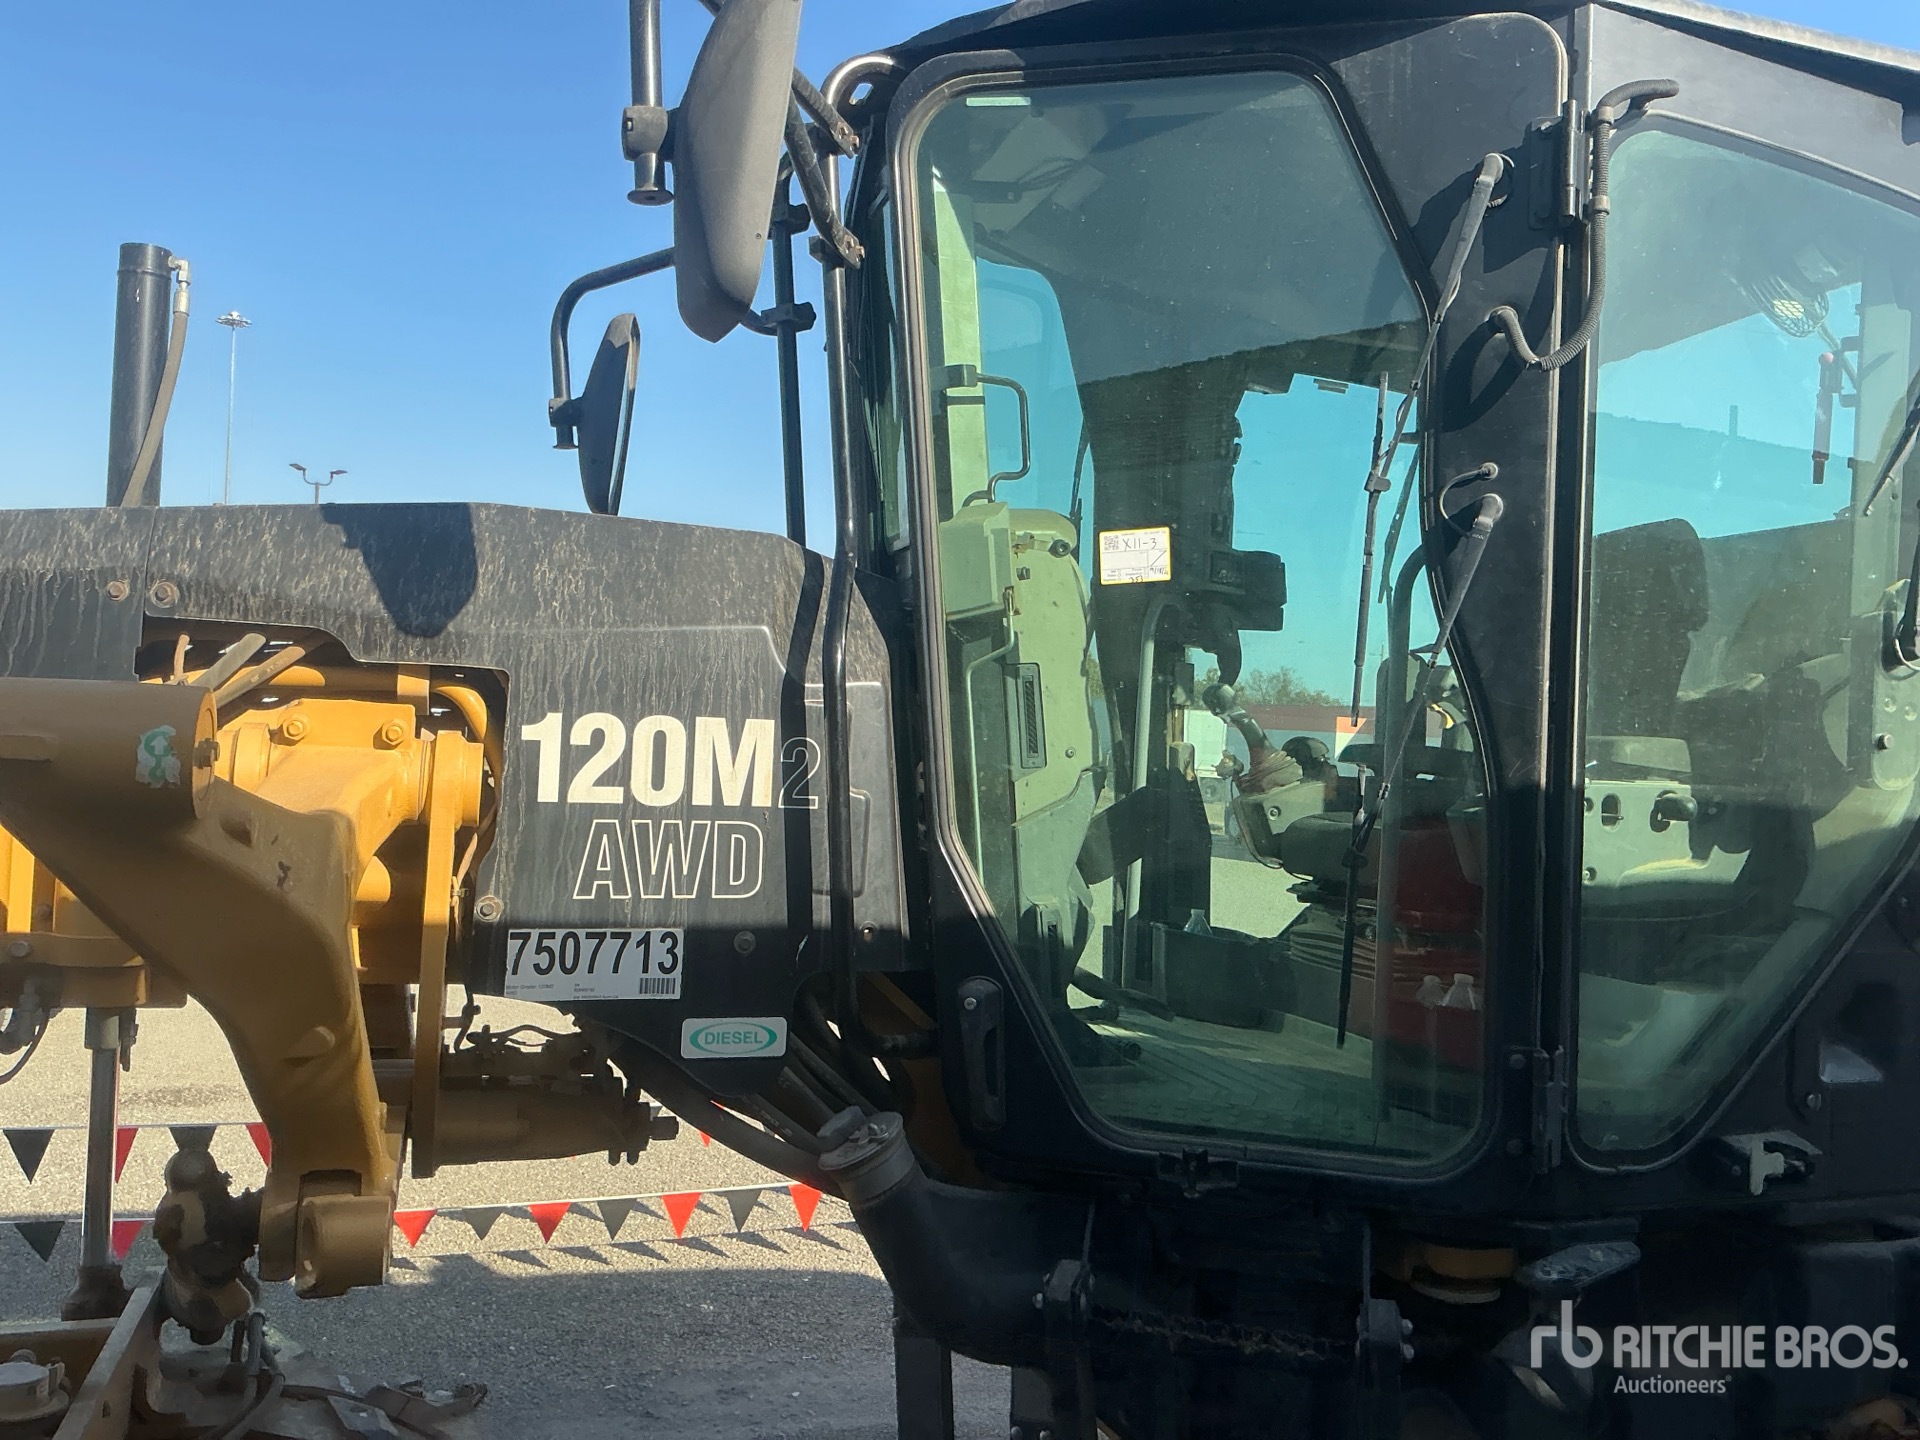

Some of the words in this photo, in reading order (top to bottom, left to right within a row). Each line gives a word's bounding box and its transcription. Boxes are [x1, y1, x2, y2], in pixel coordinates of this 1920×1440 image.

[573, 819, 764, 900] AWD
[508, 931, 680, 976] 7507713
[704, 1031, 763, 1045] DIESEL
